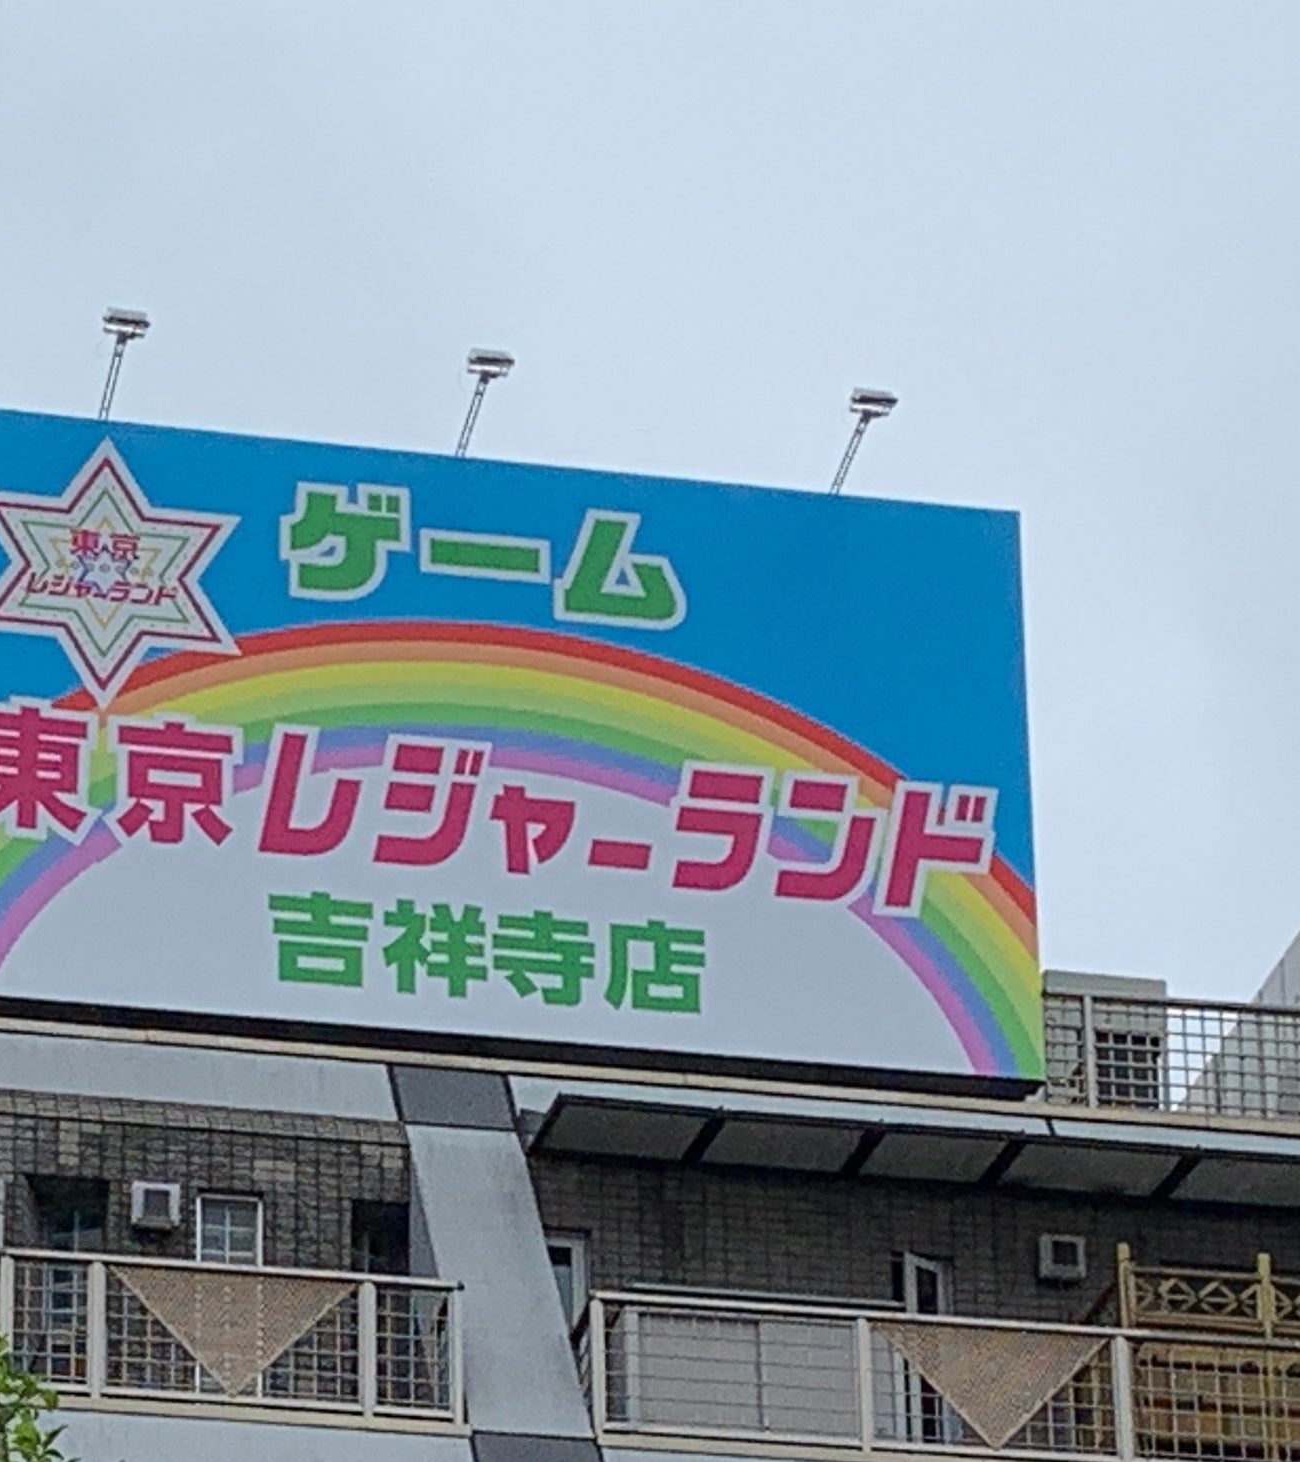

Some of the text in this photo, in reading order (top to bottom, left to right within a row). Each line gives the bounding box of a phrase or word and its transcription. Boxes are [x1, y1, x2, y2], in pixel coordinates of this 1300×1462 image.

[70, 526, 140, 561] 東京
[284, 487, 682, 625] ゲーム
[27, 571, 178, 606] レジャーランド
[267, 890, 706, 1016] 吉祥寺店
